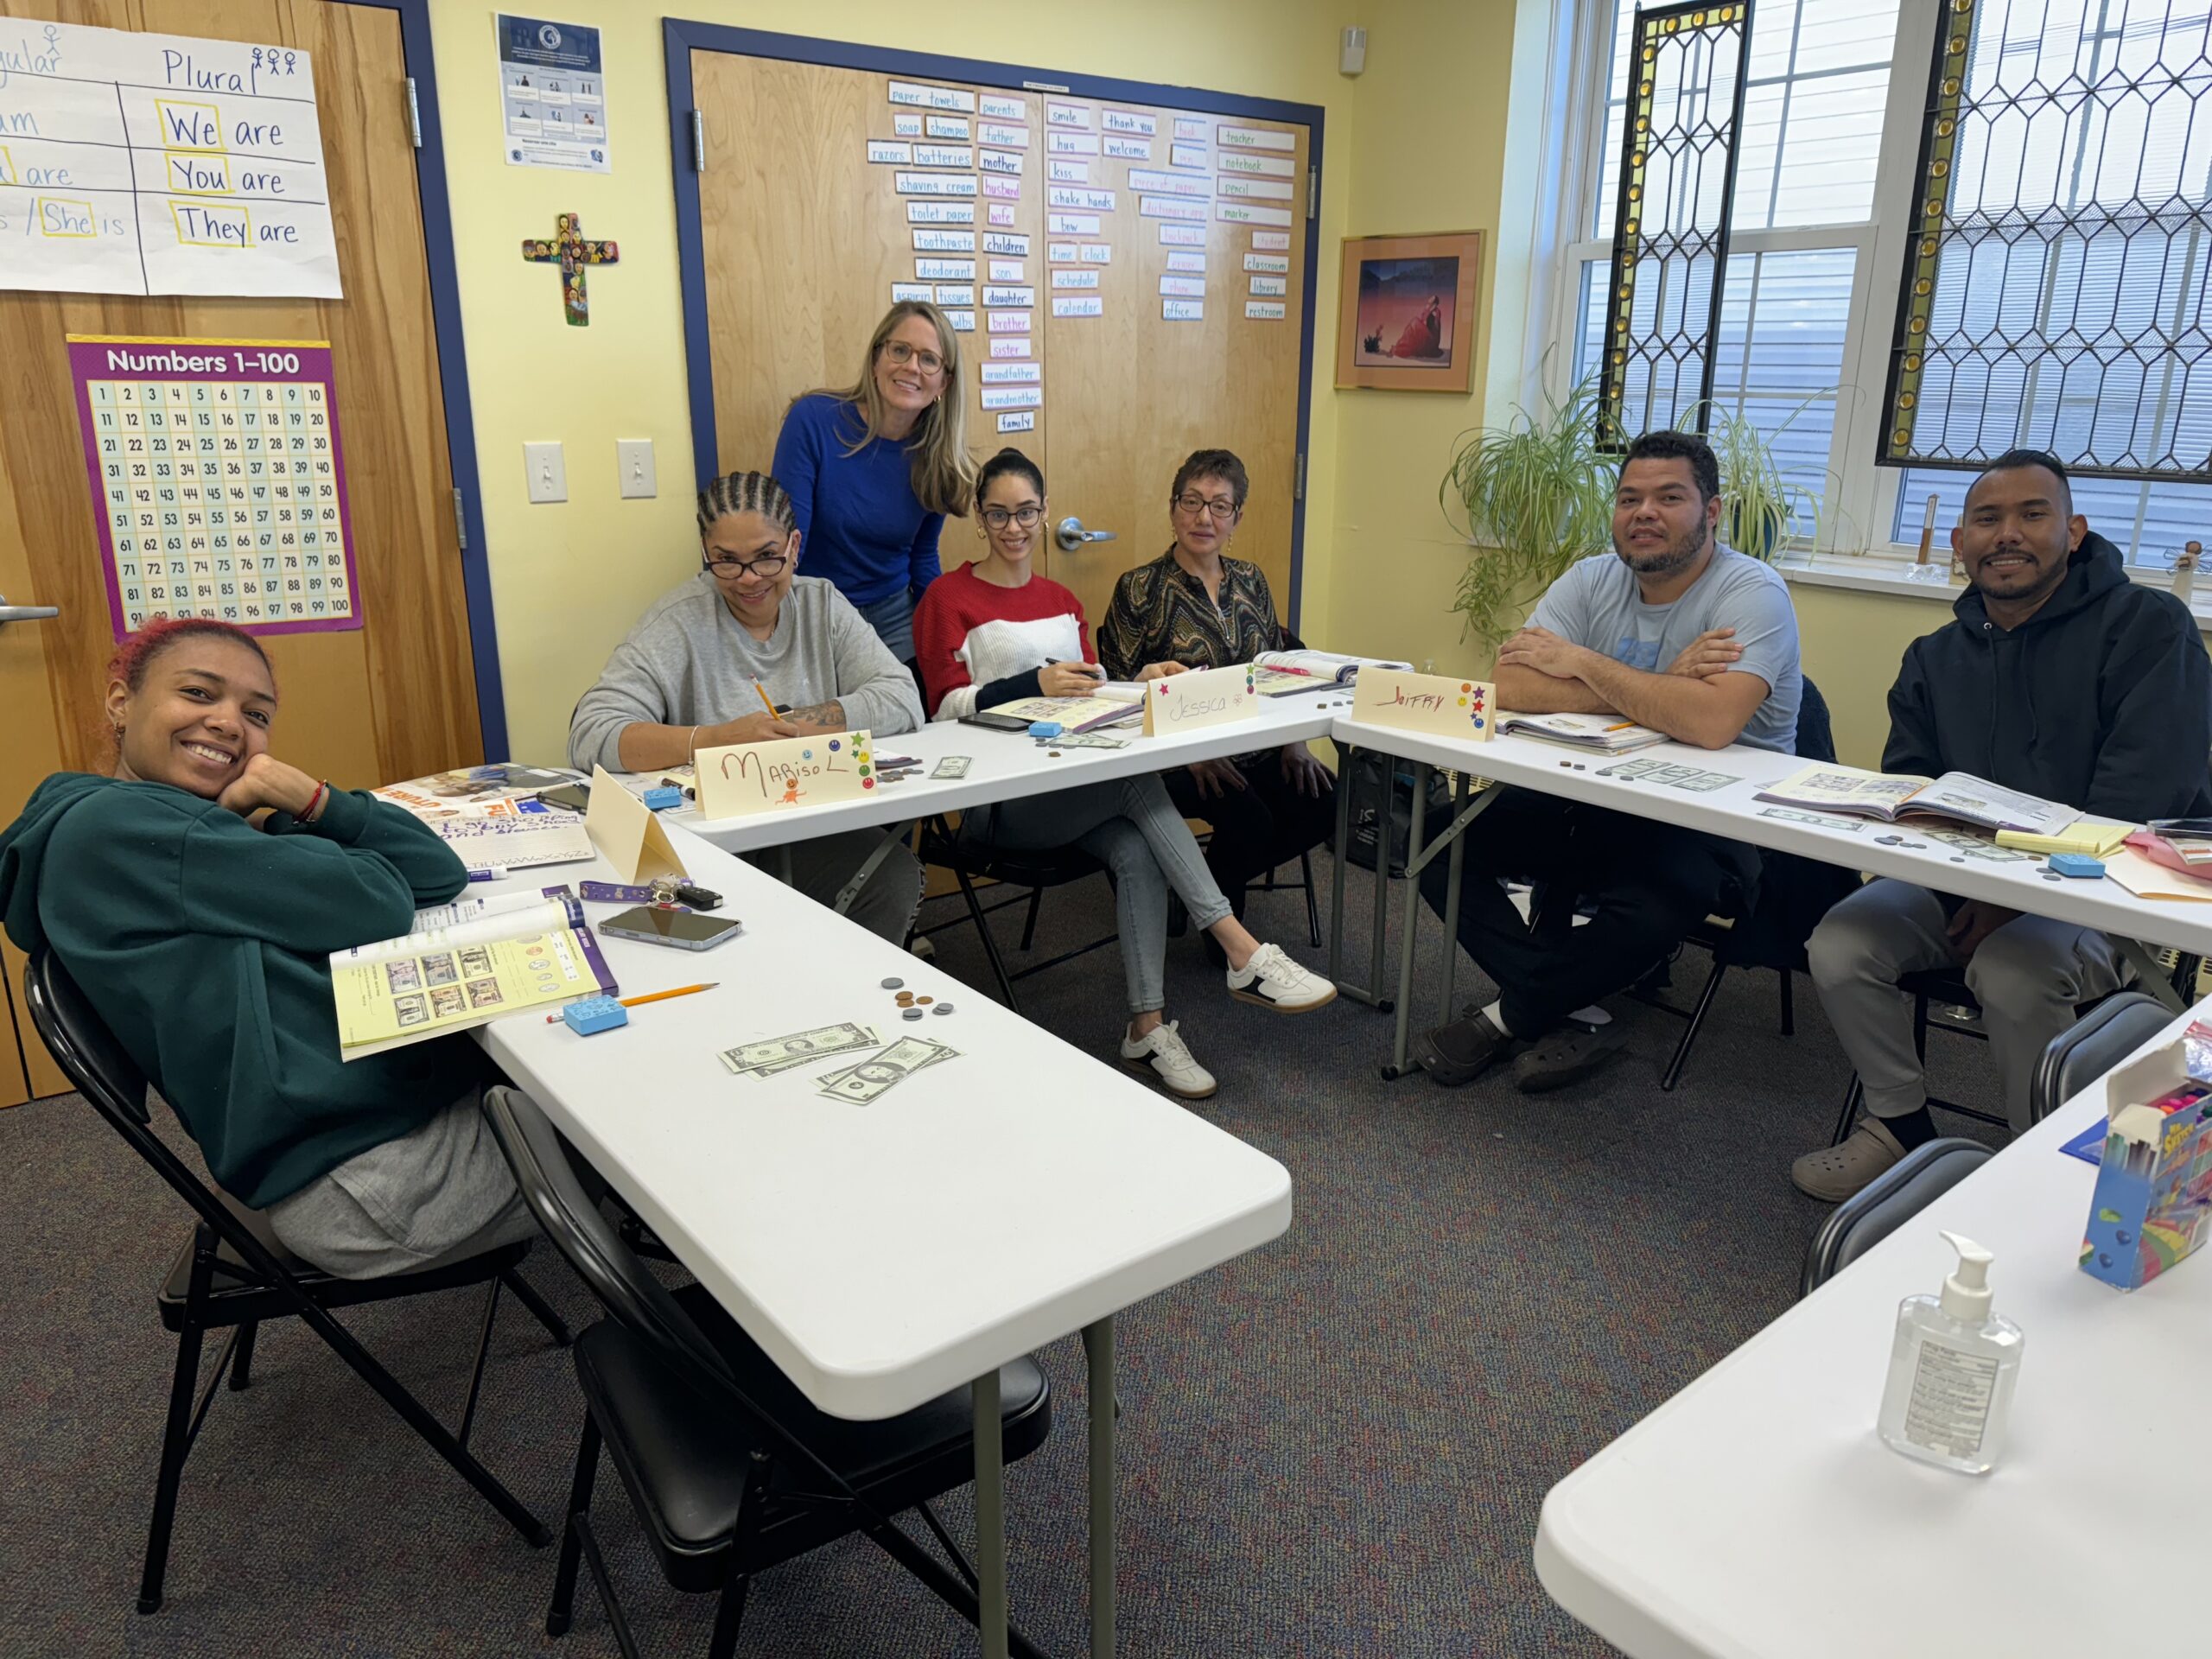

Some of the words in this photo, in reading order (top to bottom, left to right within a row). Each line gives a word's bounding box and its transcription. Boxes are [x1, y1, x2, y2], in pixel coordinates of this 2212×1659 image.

[162, 48, 257, 94] Plural
[893, 90, 920, 102] paper
[929, 92, 960, 108] towels
[982, 104, 1016, 117] parents
[1052, 109, 1077, 124] smile
[166, 108, 217, 145] We
[236, 124, 283, 145] are
[897, 122, 919, 135] soap
[931, 119, 968, 136] shampoo
[1109, 115, 1135, 129] thank
[1140, 122, 1153, 134] you
[985, 126, 1015, 144] father
[1226, 131, 1255, 144] teacher
[1057, 135, 1075, 152] hug
[1109, 142, 1147, 157] welcome
[873, 150, 905, 161] razors
[917, 146, 970, 165] batteries
[983, 155, 1017, 171] mother
[1053, 162, 1073, 179] kiss
[1226, 158, 1262, 172] notebook
[27, 168, 73, 186] are
[172, 160, 226, 189] You
[242, 172, 285, 193] are
[900, 175, 938, 193] shaving
[946, 181, 975, 193] cream
[985, 178, 1020, 197] husband
[1225, 182, 1249, 196] pencil
[1054, 190, 1080, 206] shake
[1088, 194, 1112, 208] hands
[912, 203, 939, 219] toilet
[946, 210, 973, 222] paper
[990, 207, 1011, 223] wife
[1224, 207, 1250, 219] marker
[104, 213, 124, 236] is
[178, 207, 246, 247] They
[260, 222, 298, 243] are
[916, 232, 973, 250] toothpaste
[987, 235, 1025, 252] children
[1052, 246, 1072, 259] time
[1084, 247, 1107, 260] clock
[920, 262, 971, 277] deodorant
[1247, 257, 1286, 271] classroom
[996, 269, 1011, 279] son
[1057, 271, 1095, 286] schedule
[1254, 279, 1278, 294] library
[938, 289, 970, 303] tissues
[988, 290, 1027, 306] daughter
[1058, 300, 1099, 315] calendar
[1166, 303, 1190, 317] office
[1249, 306, 1283, 318] restroom
[992, 315, 1027, 330] brother
[994, 344, 1020, 356] sister
[107, 349, 226, 372] Numbers
[985, 366, 1035, 381] grandfather
[99, 388, 105, 400] 1
[124, 388, 131, 400] 2
[149, 388, 156, 400] 3
[173, 389, 180, 400] 4
[198, 389, 204, 400] 5
[220, 389, 227, 400] 6
[243, 389, 249, 400] 7
[266, 389, 273, 401] 8
[289, 390, 296, 401] 9
[309, 390, 320, 401] 10
[986, 392, 1039, 405] grandmother
[101, 414, 111, 425] 11
[126, 414, 138, 425] 12
[150, 414, 162, 425] 13
[175, 414, 187, 425] 14
[199, 414, 210, 425] 15
[222, 414, 233, 425] 16
[245, 414, 255, 425] 17
[268, 414, 278, 425] 18
[290, 414, 301, 425] 19
[311, 414, 323, 425] 20
[1001, 412, 1030, 429] family
[105, 439, 116, 451] 21
[129, 439, 143, 451] 22
[153, 439, 166, 450] 23
[176, 439, 190, 451] 24
[200, 438, 213, 450] 25
[224, 438, 237, 450] 26
[247, 438, 258, 449] 27
[270, 438, 282, 449] 28
[292, 438, 304, 449] 29
[315, 438, 326, 448] 30
[108, 465, 119, 476] 31
[133, 464, 146, 476] 32
[156, 464, 170, 475] 33
[181, 464, 194, 475] 34
[204, 463, 217, 474] 35
[227, 463, 240, 474] 36
[251, 462, 262, 474] 37
[273, 462, 285, 474] 38
[296, 461, 307, 474] 39
[316, 462, 329, 473] 40
[112, 491, 124, 502] 41
[136, 490, 150, 501] 42
[160, 489, 174, 501] 43
[183, 488, 198, 499] 44
[207, 488, 220, 499] 45
[231, 487, 244, 499] 46
[253, 487, 265, 498] 47
[276, 486, 289, 498] 48
[298, 486, 310, 497] 49
[321, 485, 332, 496] 50
